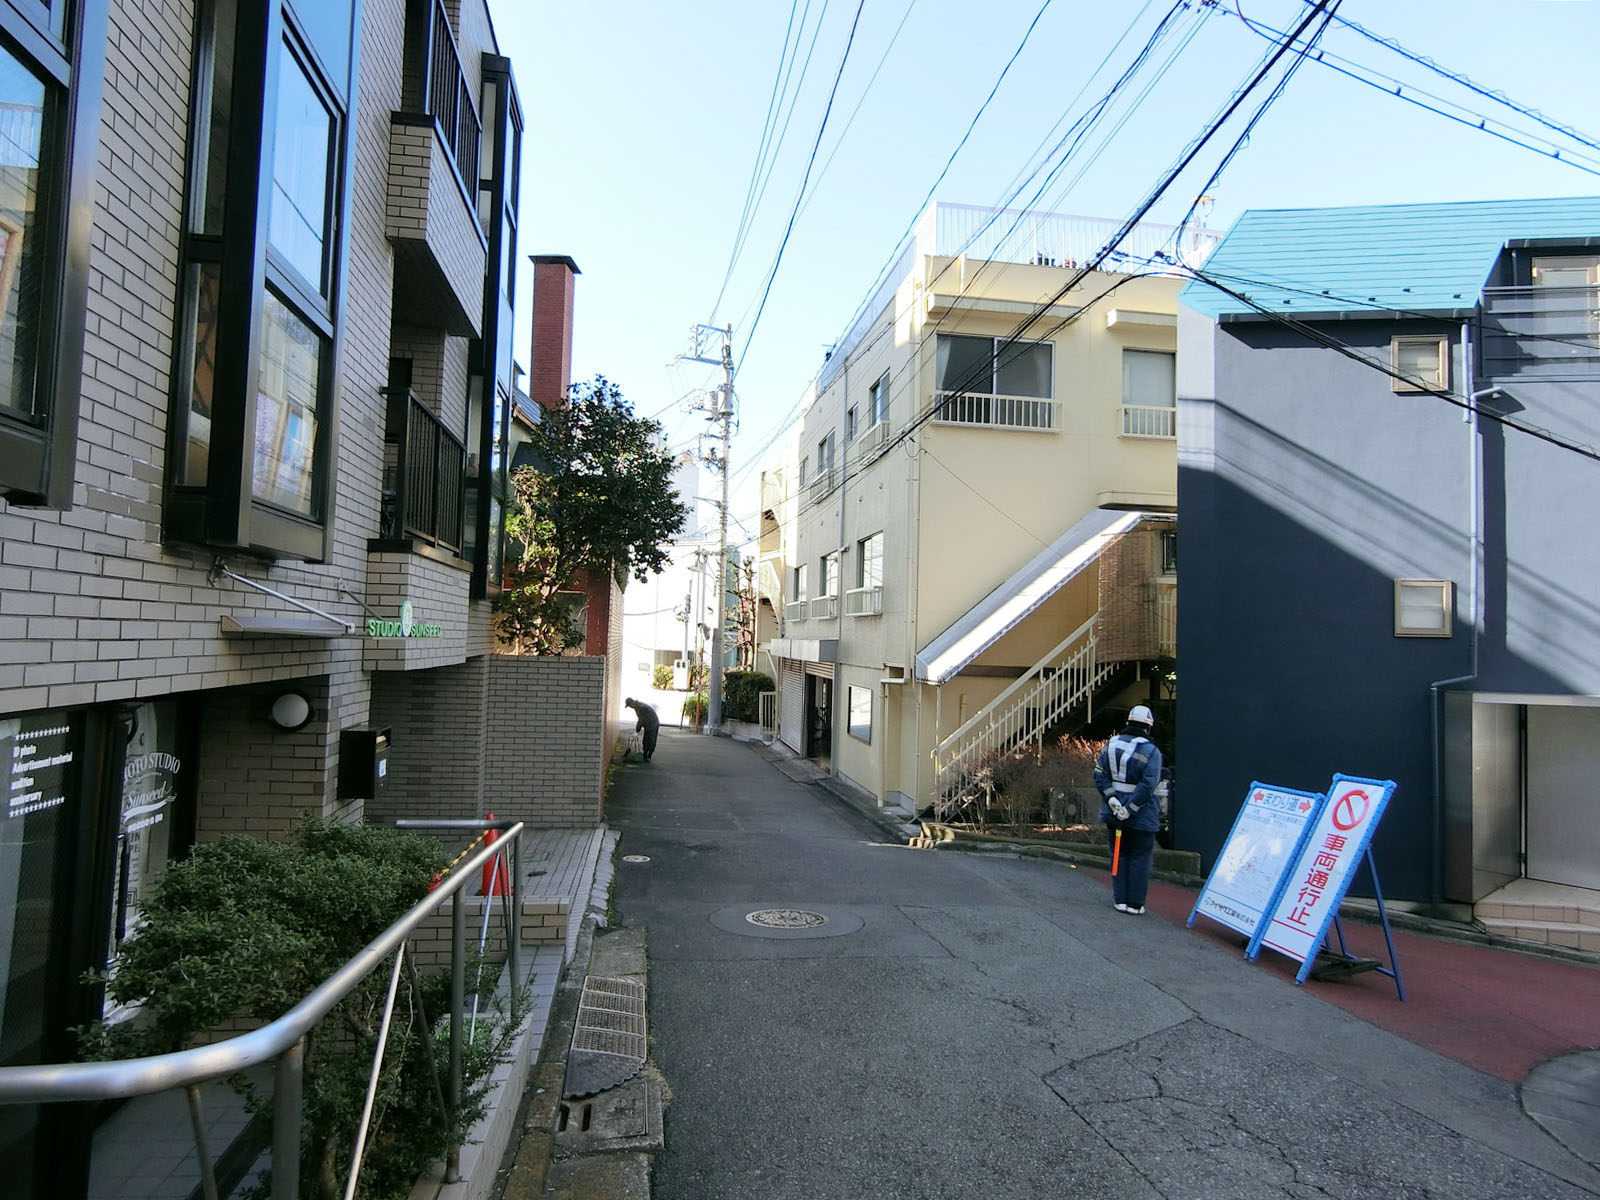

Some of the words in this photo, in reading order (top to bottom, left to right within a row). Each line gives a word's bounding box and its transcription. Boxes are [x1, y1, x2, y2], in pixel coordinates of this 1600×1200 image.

[368, 619, 402, 637] STUDIO
[411, 623, 443, 638] SUNSEED
[149, 752, 181, 774] STUDIO
[126, 780, 173, 810] Sunseed
[1263, 792, 1300, 812] まわり道
[1286, 833, 1348, 927] 車両通行止
